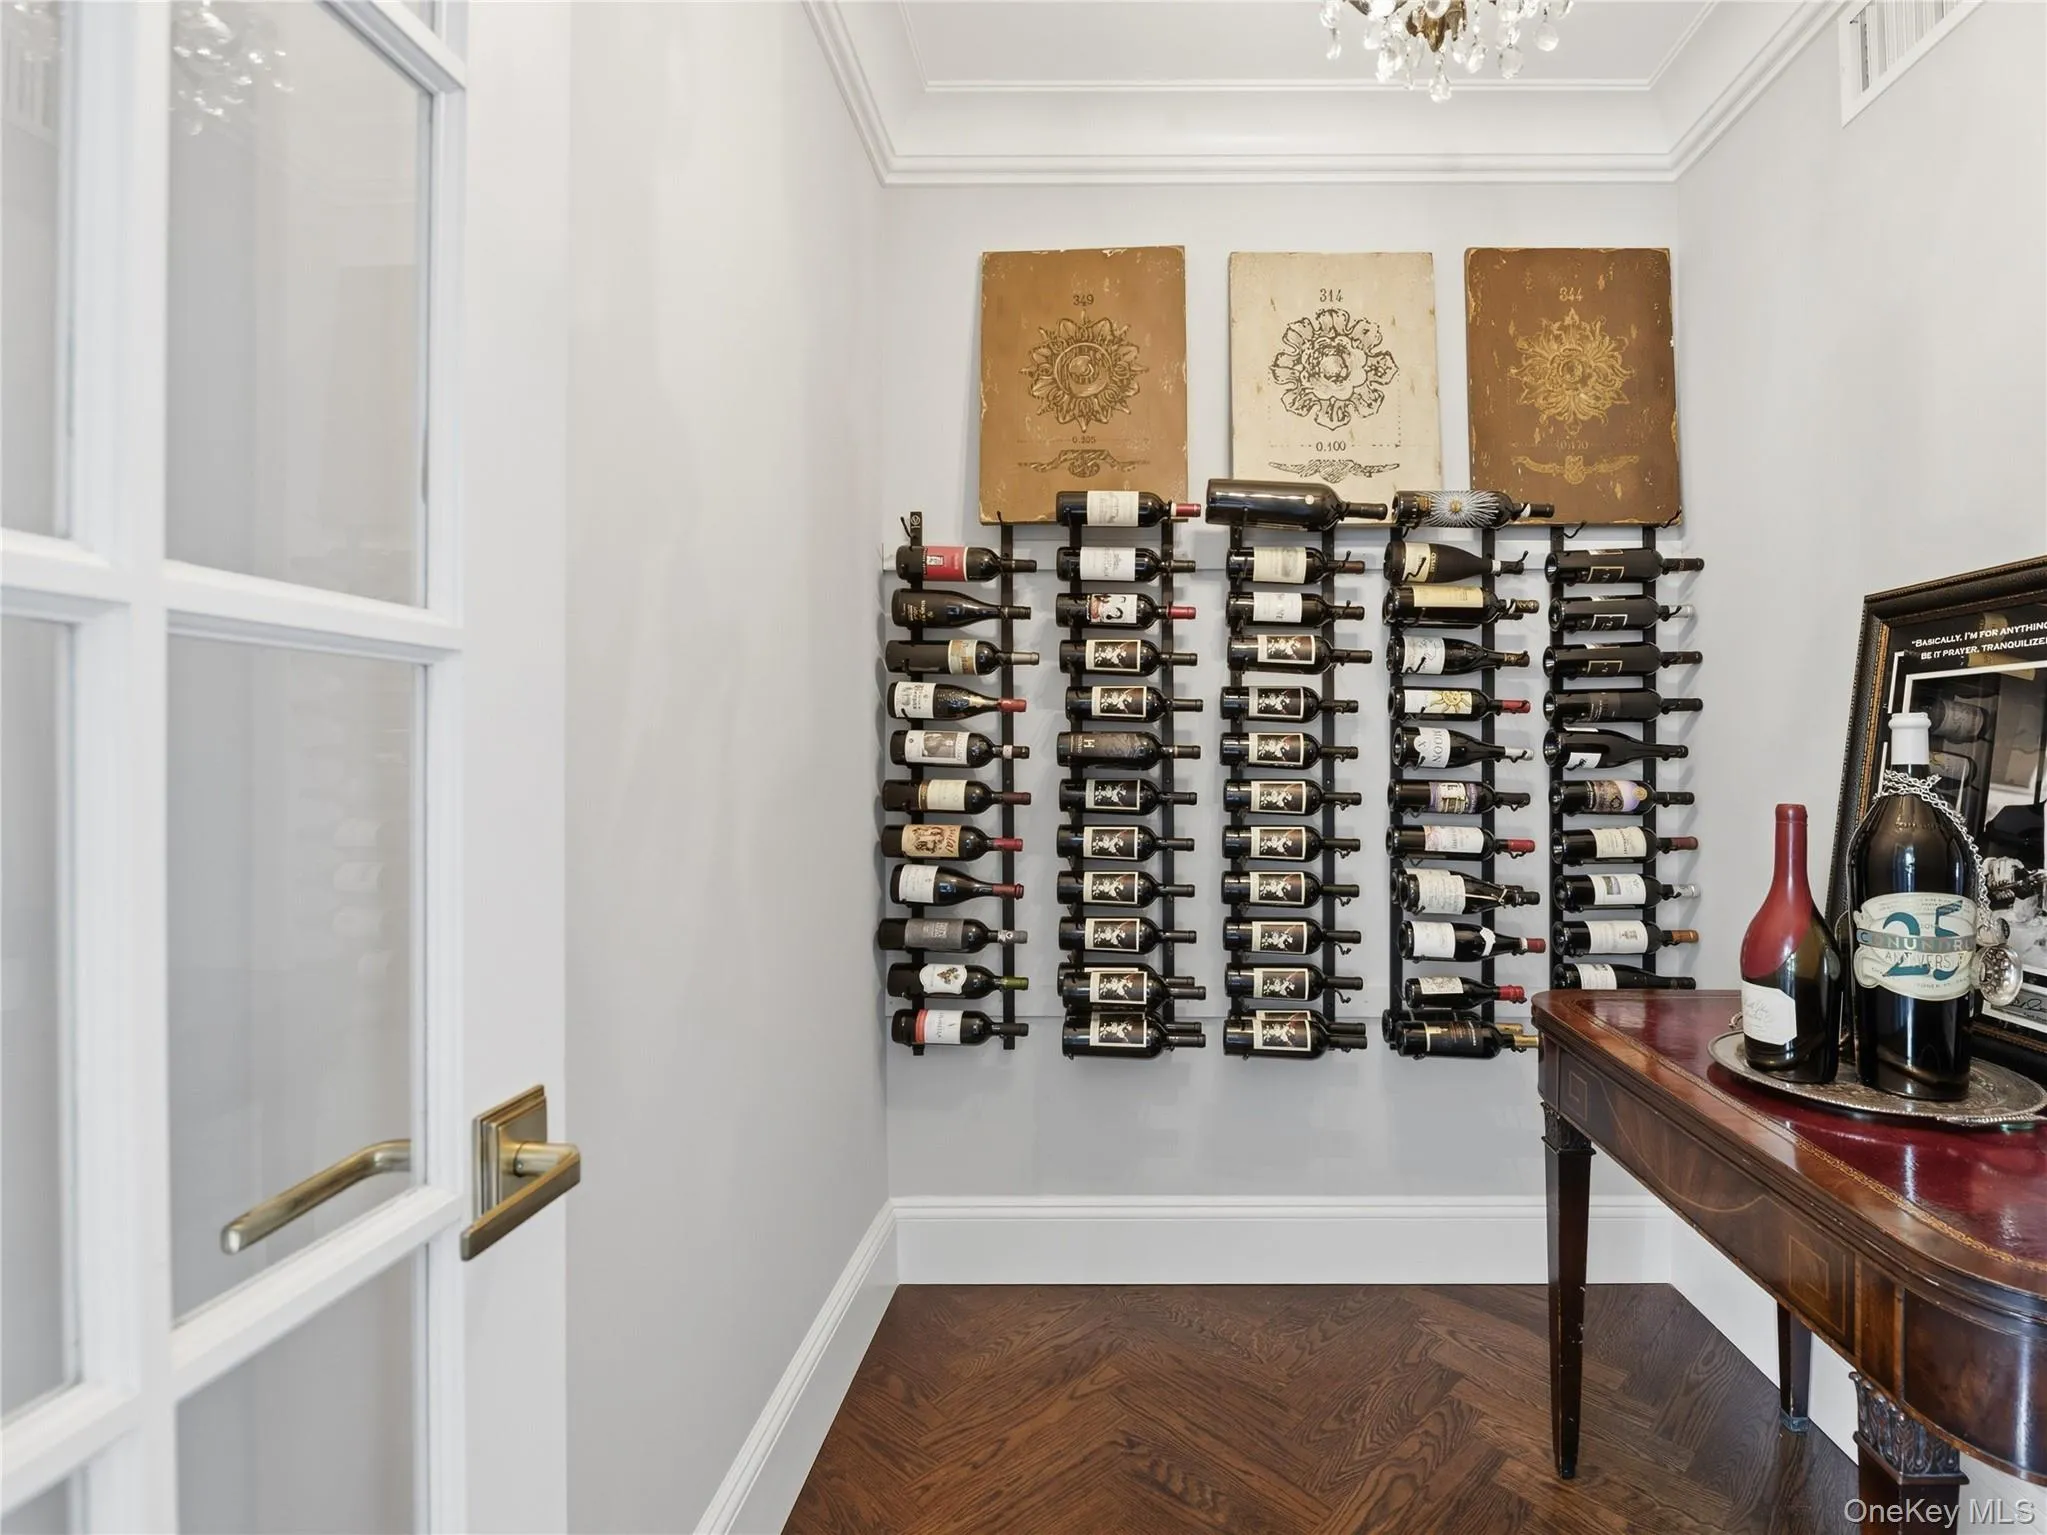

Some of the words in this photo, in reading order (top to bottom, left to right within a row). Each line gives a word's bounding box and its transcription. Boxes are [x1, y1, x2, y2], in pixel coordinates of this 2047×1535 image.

[1072, 294, 1095, 307] 349
[1319, 287, 1344, 303] 314
[1315, 440, 1346, 452] 0.100
[1964, 631, 1979, 641] I'M
[1979, 628, 1999, 639] FOR
[1920, 651, 1933, 660] BE
[1933, 650, 1942, 659] IT
[1431, 729, 1444, 763] MOON
